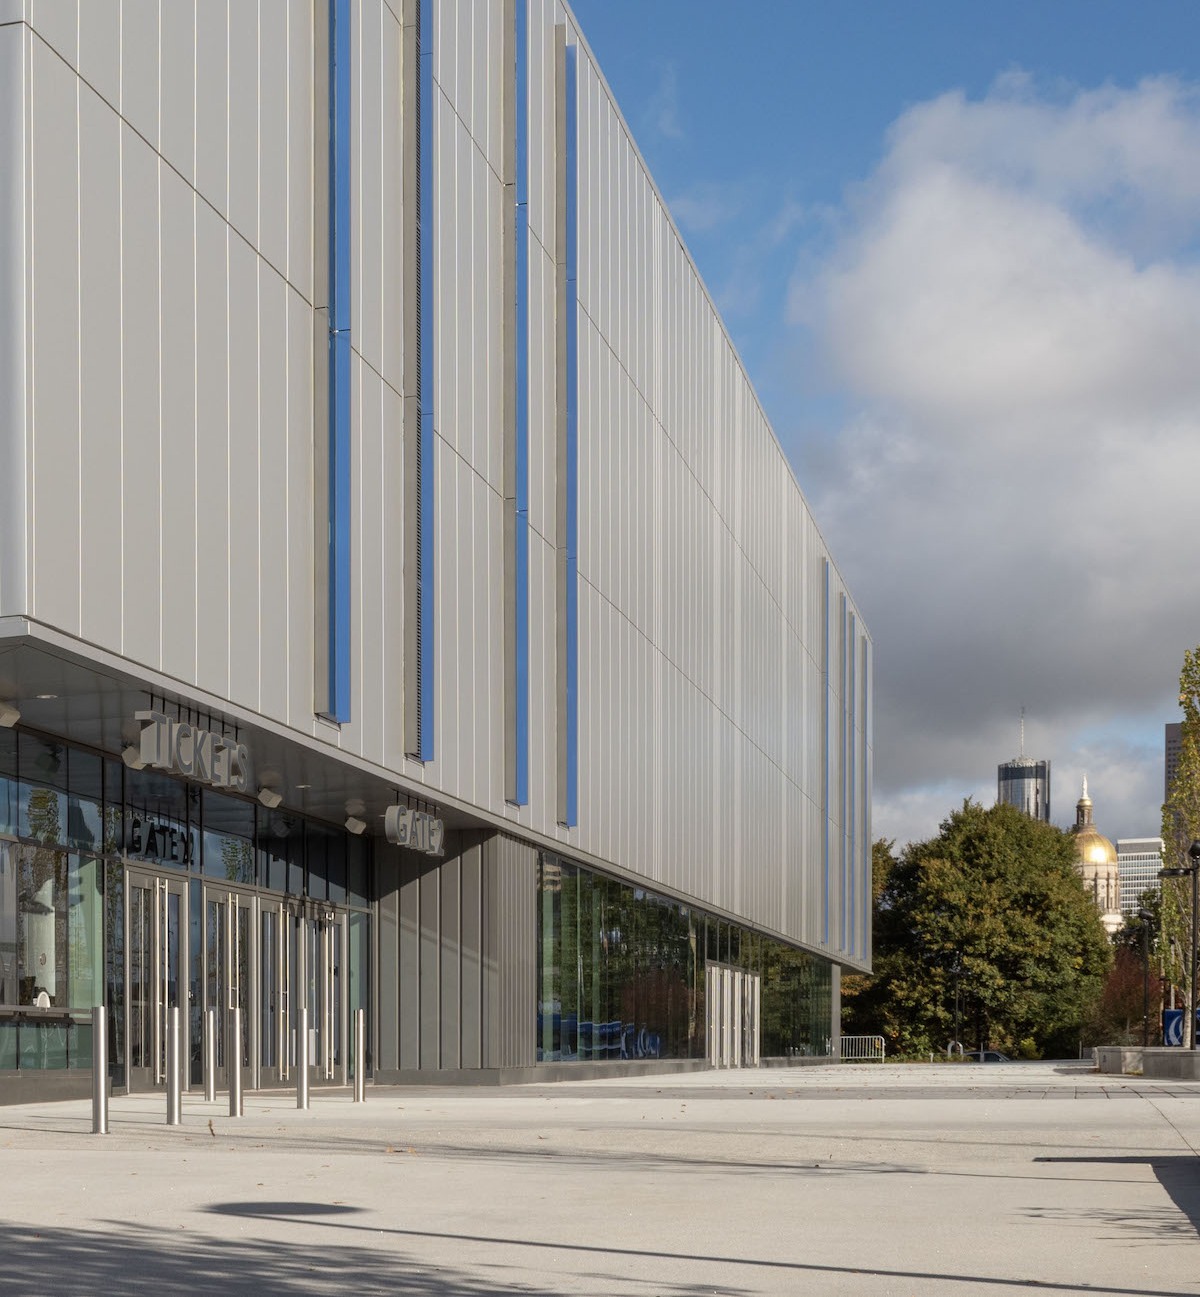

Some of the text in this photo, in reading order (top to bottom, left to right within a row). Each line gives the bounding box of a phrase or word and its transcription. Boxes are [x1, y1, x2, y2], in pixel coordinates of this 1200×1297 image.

[135, 710, 249, 793] TICKETS
[130, 817, 178, 861] GATE
[385, 804, 444, 856] GATE 2
